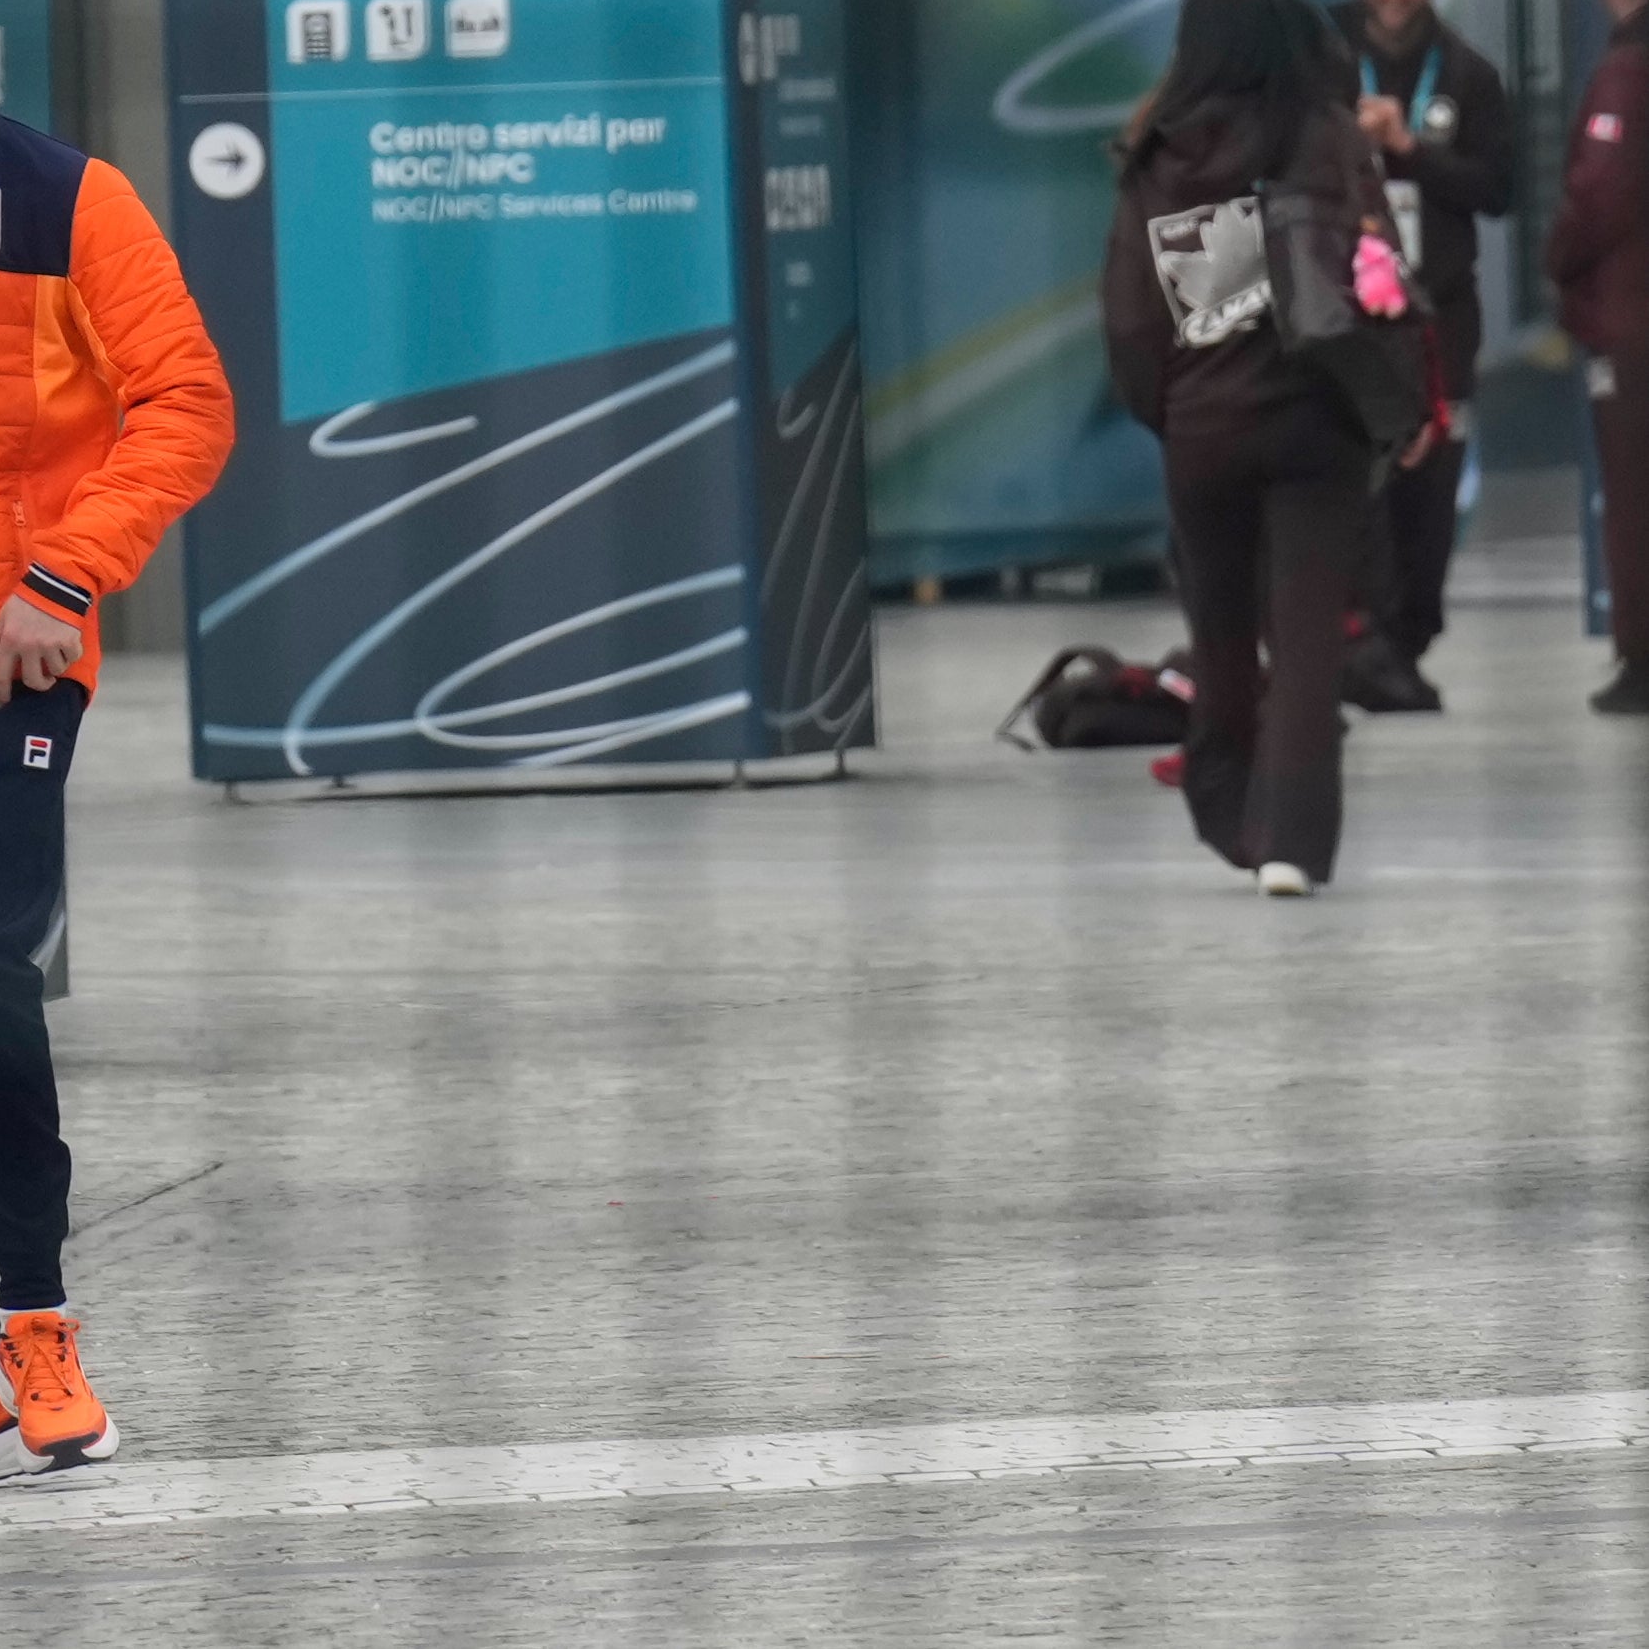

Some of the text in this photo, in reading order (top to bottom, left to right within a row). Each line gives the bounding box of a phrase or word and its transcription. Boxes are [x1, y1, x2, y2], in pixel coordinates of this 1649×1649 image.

[369, 114, 666, 151] Centro servizi per
[371, 151, 535, 186] NOC/NPC
